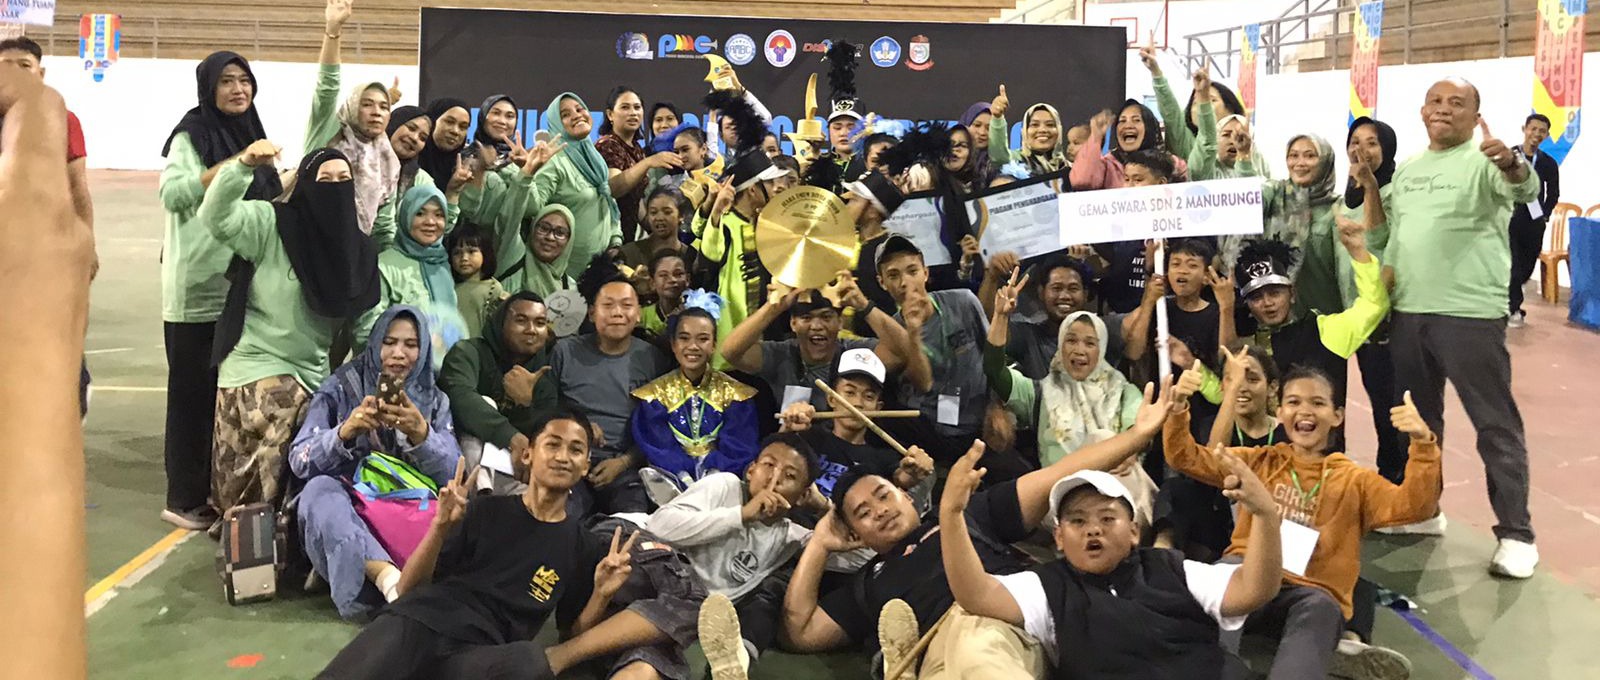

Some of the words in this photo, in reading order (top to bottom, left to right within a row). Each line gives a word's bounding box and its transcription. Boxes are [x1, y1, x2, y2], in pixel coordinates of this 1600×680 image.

[1079, 202, 1109, 217] GEMA
[1111, 200, 1147, 215] SWARA
[1150, 197, 1173, 212] SDN
[1176, 196, 1183, 210] 2
[1186, 191, 1261, 209] MANURUNGE
[1152, 217, 1183, 232] BONE
